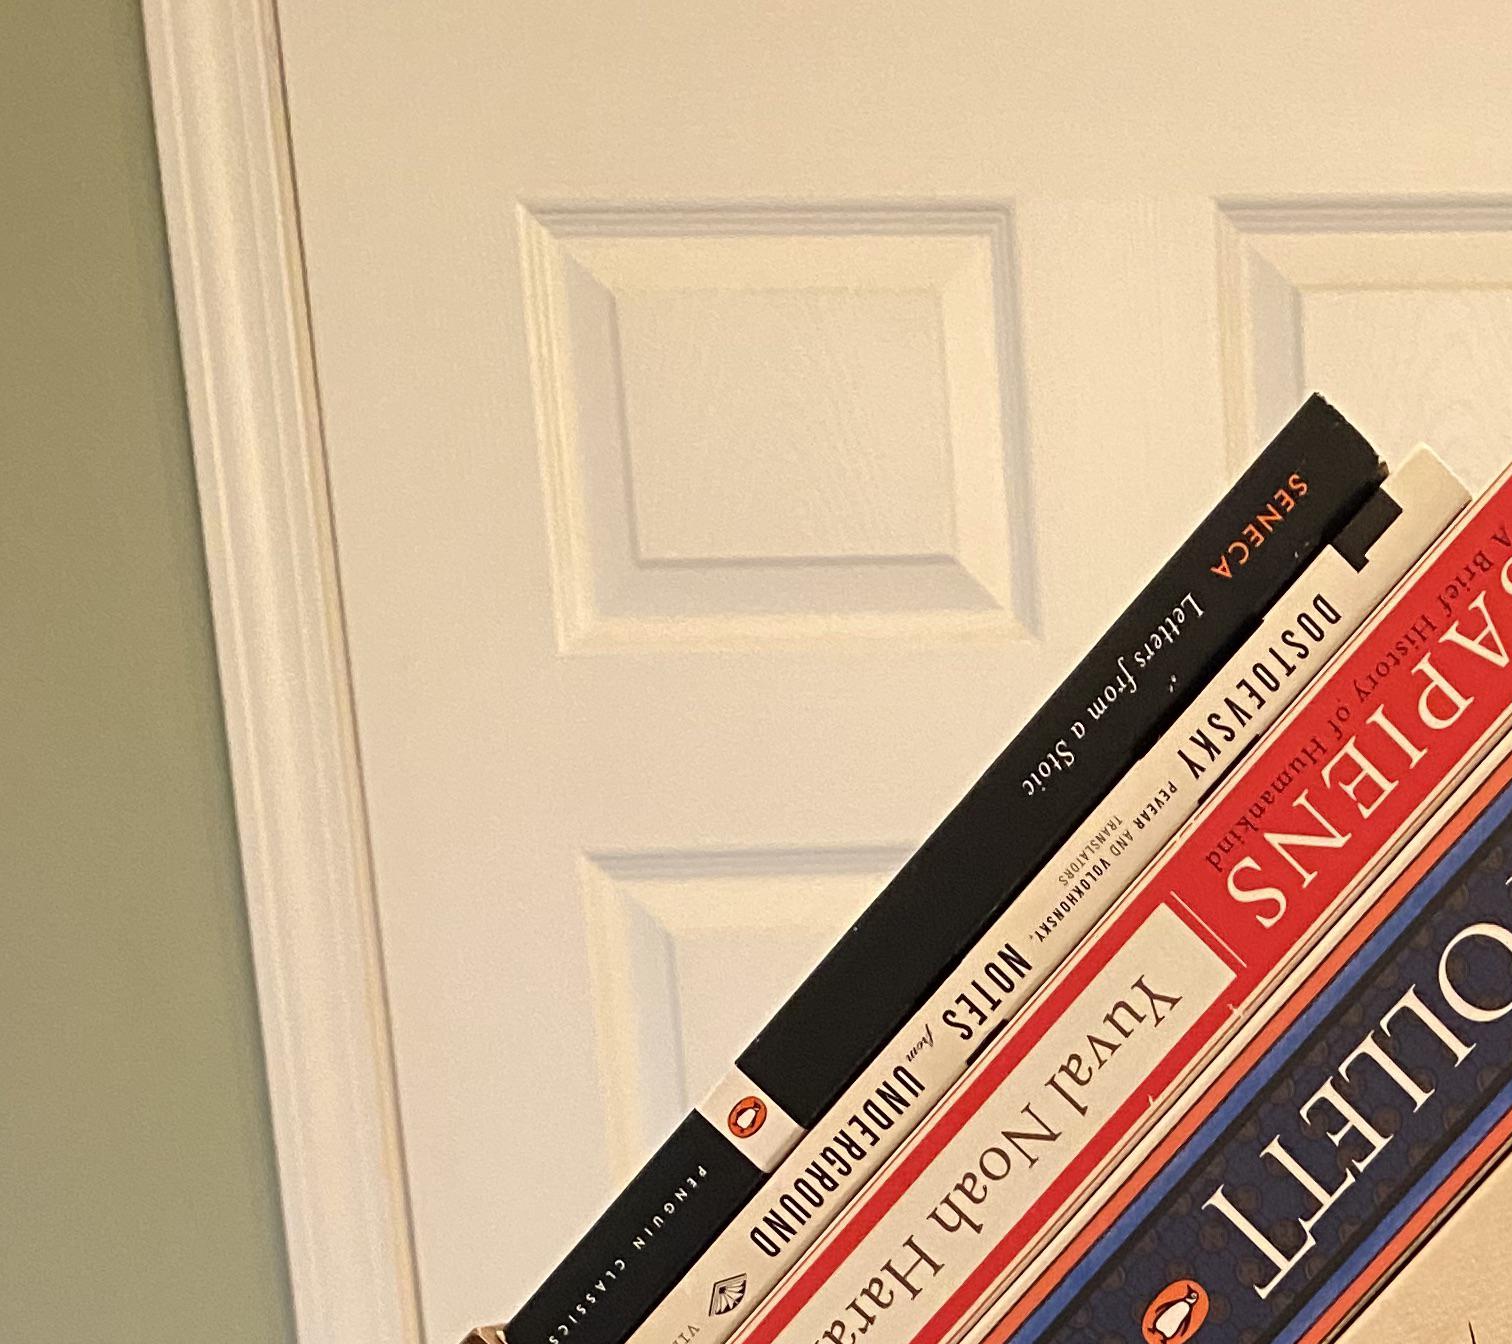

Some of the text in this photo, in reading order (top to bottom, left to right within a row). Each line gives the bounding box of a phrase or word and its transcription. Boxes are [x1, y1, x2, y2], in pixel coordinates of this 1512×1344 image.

[1210, 473, 1308, 578] SENECA
[1022, 592, 1204, 796] Letters from a Stoic
[1176, 593, 1342, 780] DOSTOEVSKY
[1205, 527, 1512, 874] A Brief History of Humankind
[1058, 815, 1123, 887] TRANSLATORS
[1109, 829, 1134, 857] AND
[1132, 780, 1178, 830] PEVEAR
[750, 942, 1033, 1258] NOTES from UNDERGROUND
[1044, 974, 1184, 1117] Yuval
[632, 1165, 707, 1250] PENGUIN
[926, 1102, 1063, 1235] Noah
